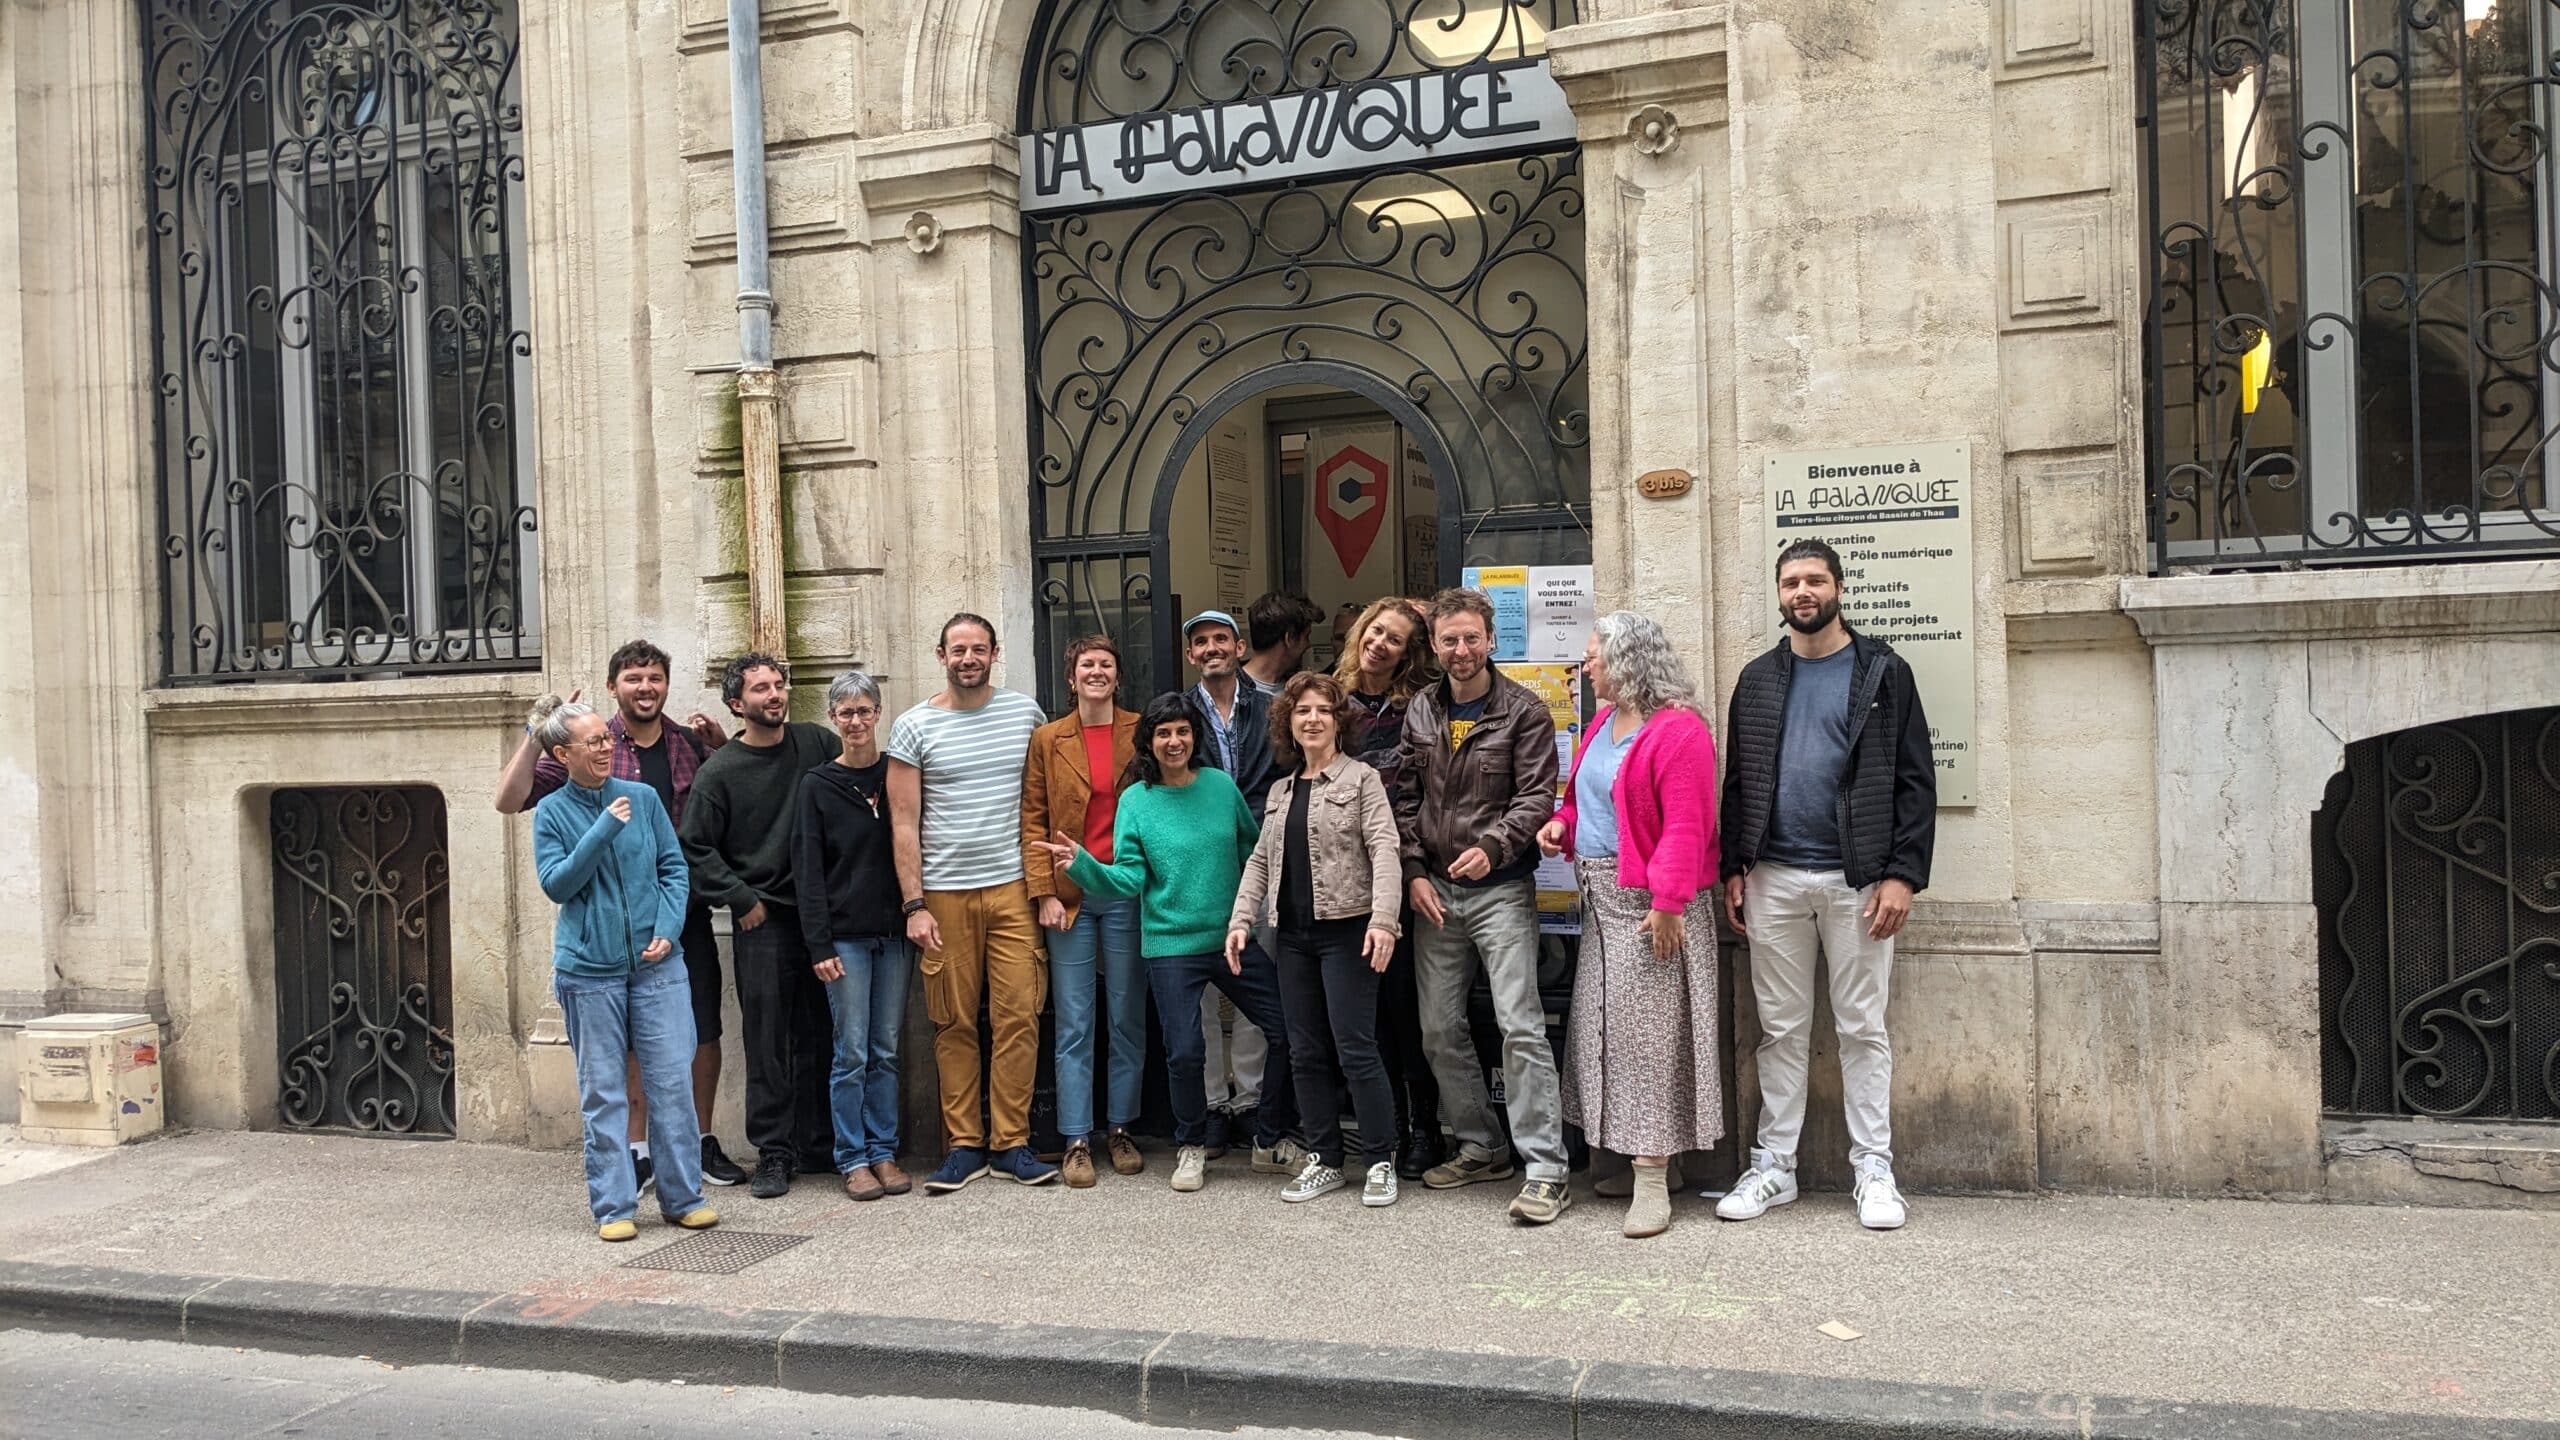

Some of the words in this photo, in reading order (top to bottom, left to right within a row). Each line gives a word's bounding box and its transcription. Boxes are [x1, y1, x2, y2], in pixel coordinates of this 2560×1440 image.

[1036, 124, 1092, 196] LA
[1808, 463, 1905, 479] Bienvenue
[1909, 459, 1921, 473] à
[1646, 480, 1656, 492] 3
[1661, 476, 1685, 491] bis
[1776, 490, 1796, 512] LA
[1791, 516, 1832, 525] Tiers-lieu
[1833, 513, 1866, 524] citoyen
[1867, 513, 1878, 521] du
[1879, 511, 1909, 520] Bassin
[1910, 510, 1921, 518] de
[1827, 533, 1876, 545] cantine
[1850, 550, 1879, 560] Pôle
[1881, 546, 1953, 559] numérique
[1562, 579, 1577, 587] QUE
[1853, 581, 1910, 595] privatifs
[1559, 590, 1585, 598] SOYEZ,
[1853, 600, 1869, 610] de
[1872, 599, 1911, 610] salles
[1871, 615, 1887, 626] de
[1890, 614, 1939, 628] projets
[1934, 758, 1955, 769] org
